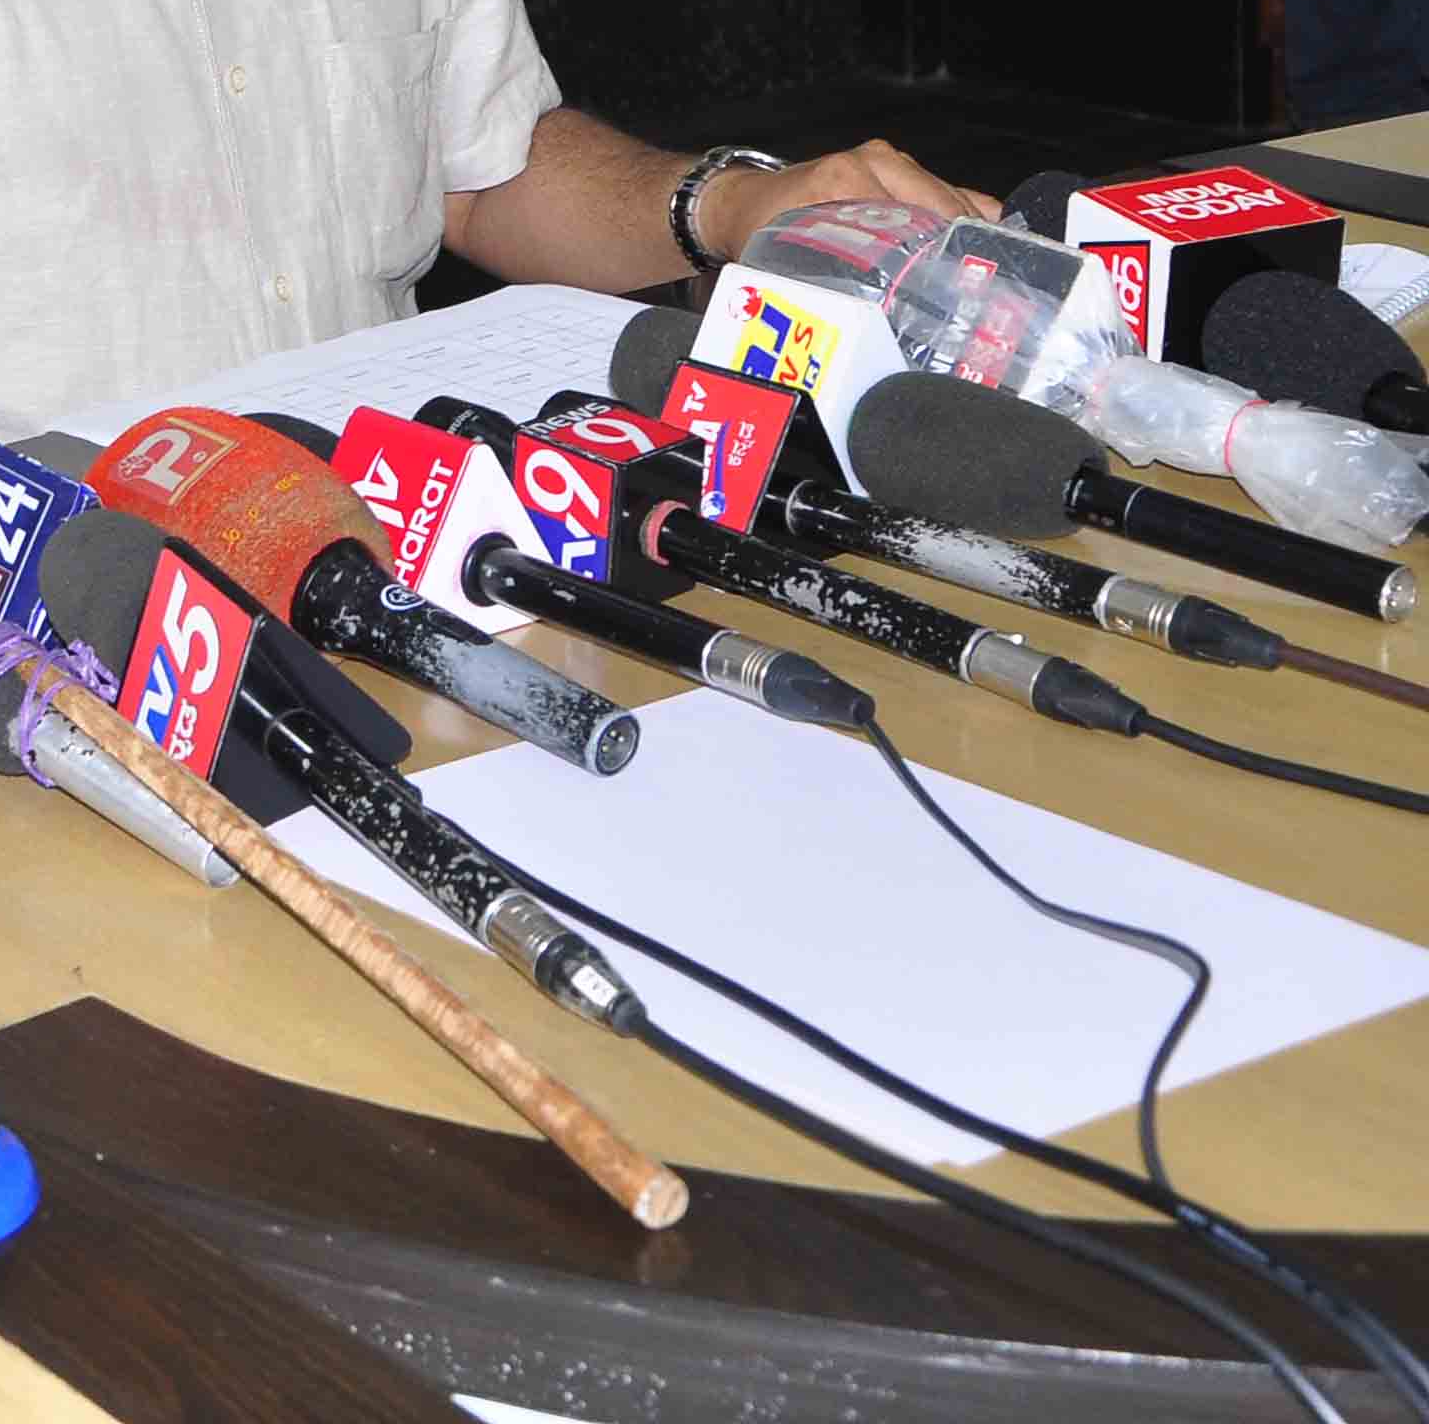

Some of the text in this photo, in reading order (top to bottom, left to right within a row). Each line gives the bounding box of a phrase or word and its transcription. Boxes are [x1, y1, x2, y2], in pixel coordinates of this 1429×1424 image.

[1137, 181, 1246, 208] INDIA
[1139, 188, 1287, 225] TODAY
[681, 379, 709, 414] TV
[572, 417, 657, 454] 9
